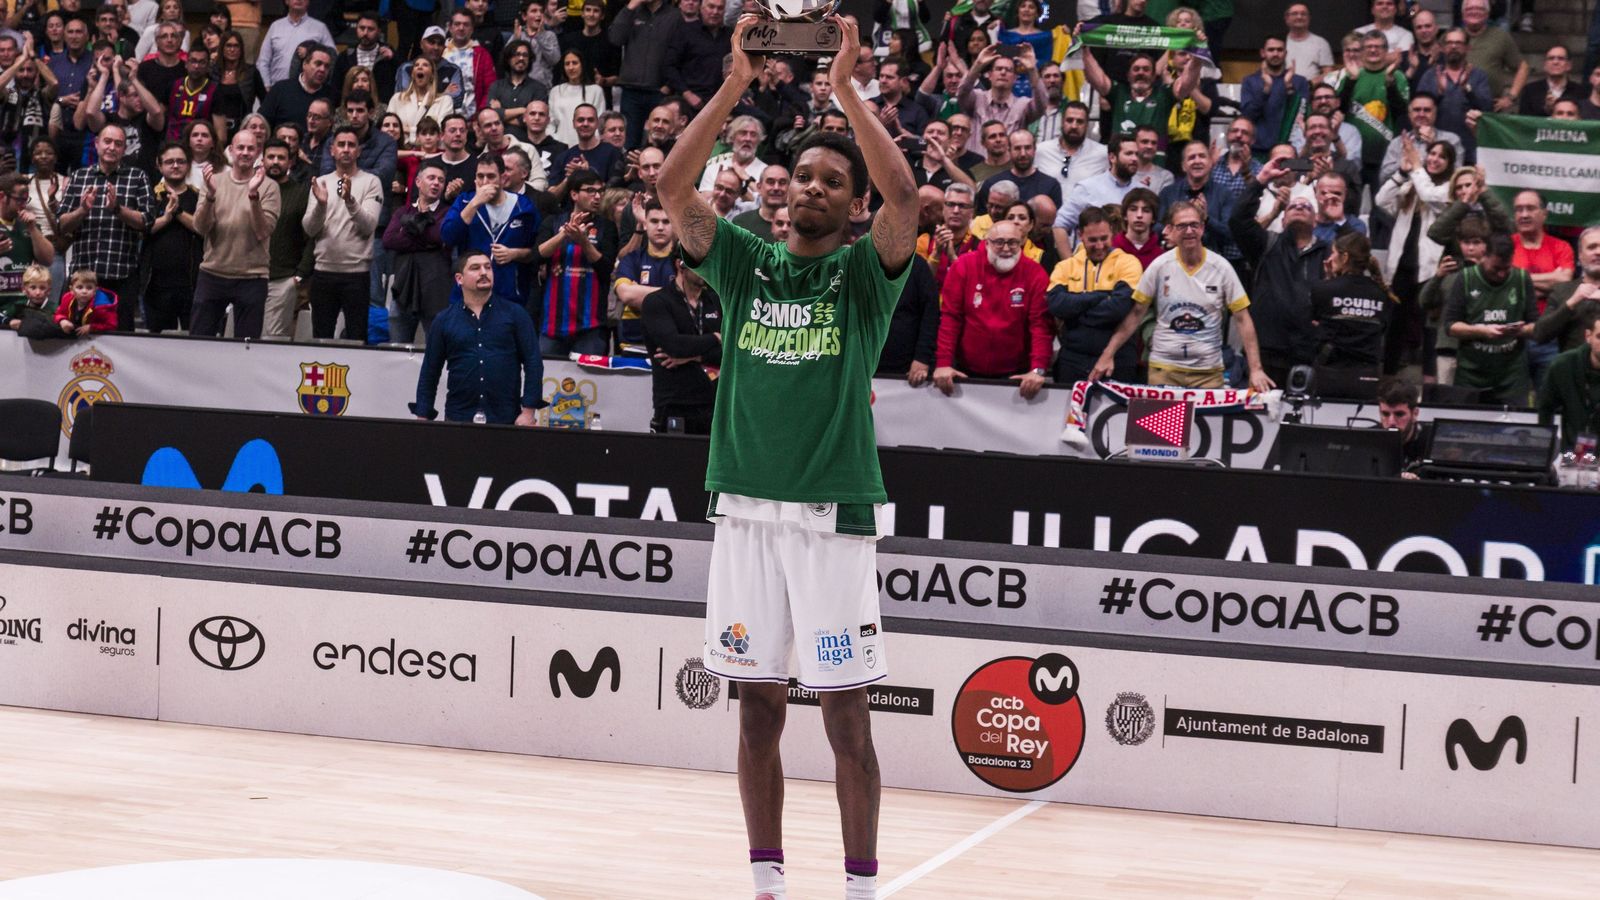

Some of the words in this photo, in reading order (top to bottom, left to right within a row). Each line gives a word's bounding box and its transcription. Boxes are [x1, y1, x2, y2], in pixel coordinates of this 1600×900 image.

[180, 100, 193, 116] 11
[1534, 129, 1588, 142] JIMENA
[1546, 202, 1574, 215] AEN
[814, 303, 835, 313] 22
[1332, 297, 1384, 311] DOUBLE
[1341, 307, 1375, 317] GROUP
[814, 314, 834, 325] 23
[738, 321, 840, 356] CAMPEONES
[1142, 448, 1179, 457] MONDO
[93, 506, 342, 558] #CopaACB
[406, 529, 673, 583] #CopaACB
[1099, 577, 1400, 637] #CopaACB
[66, 618, 135, 645] divina
[1477, 604, 1600, 660] #Co
[99, 646, 135, 657] seguros
[313, 638, 477, 682] endesa
[817, 645, 854, 666] laga
[990, 696, 1024, 710] acb
[976, 708, 1040, 733] Copa
[1176, 716, 1267, 737] Ajuntament
[1272, 723, 1291, 738] de
[1296, 726, 1369, 745] Badalona
[980, 731, 1002, 743] del
[1006, 734, 1048, 758] Rey
[968, 755, 1017, 768] Badalona
